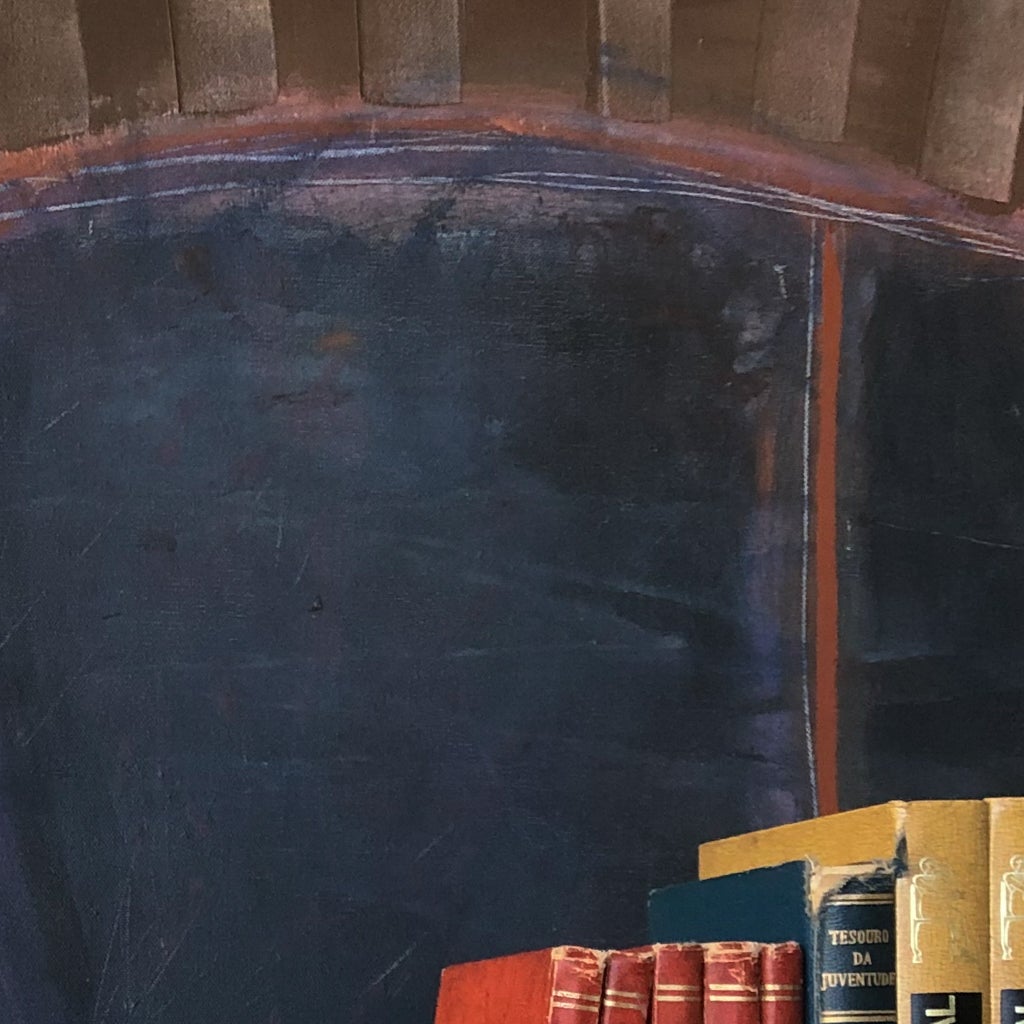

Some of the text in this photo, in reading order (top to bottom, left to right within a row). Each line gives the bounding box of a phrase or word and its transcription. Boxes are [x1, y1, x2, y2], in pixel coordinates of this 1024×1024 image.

[828, 929, 889, 945] TESOURO
[852, 952, 872, 966] DA
[820, 972, 896, 991] JUVENTUDE
